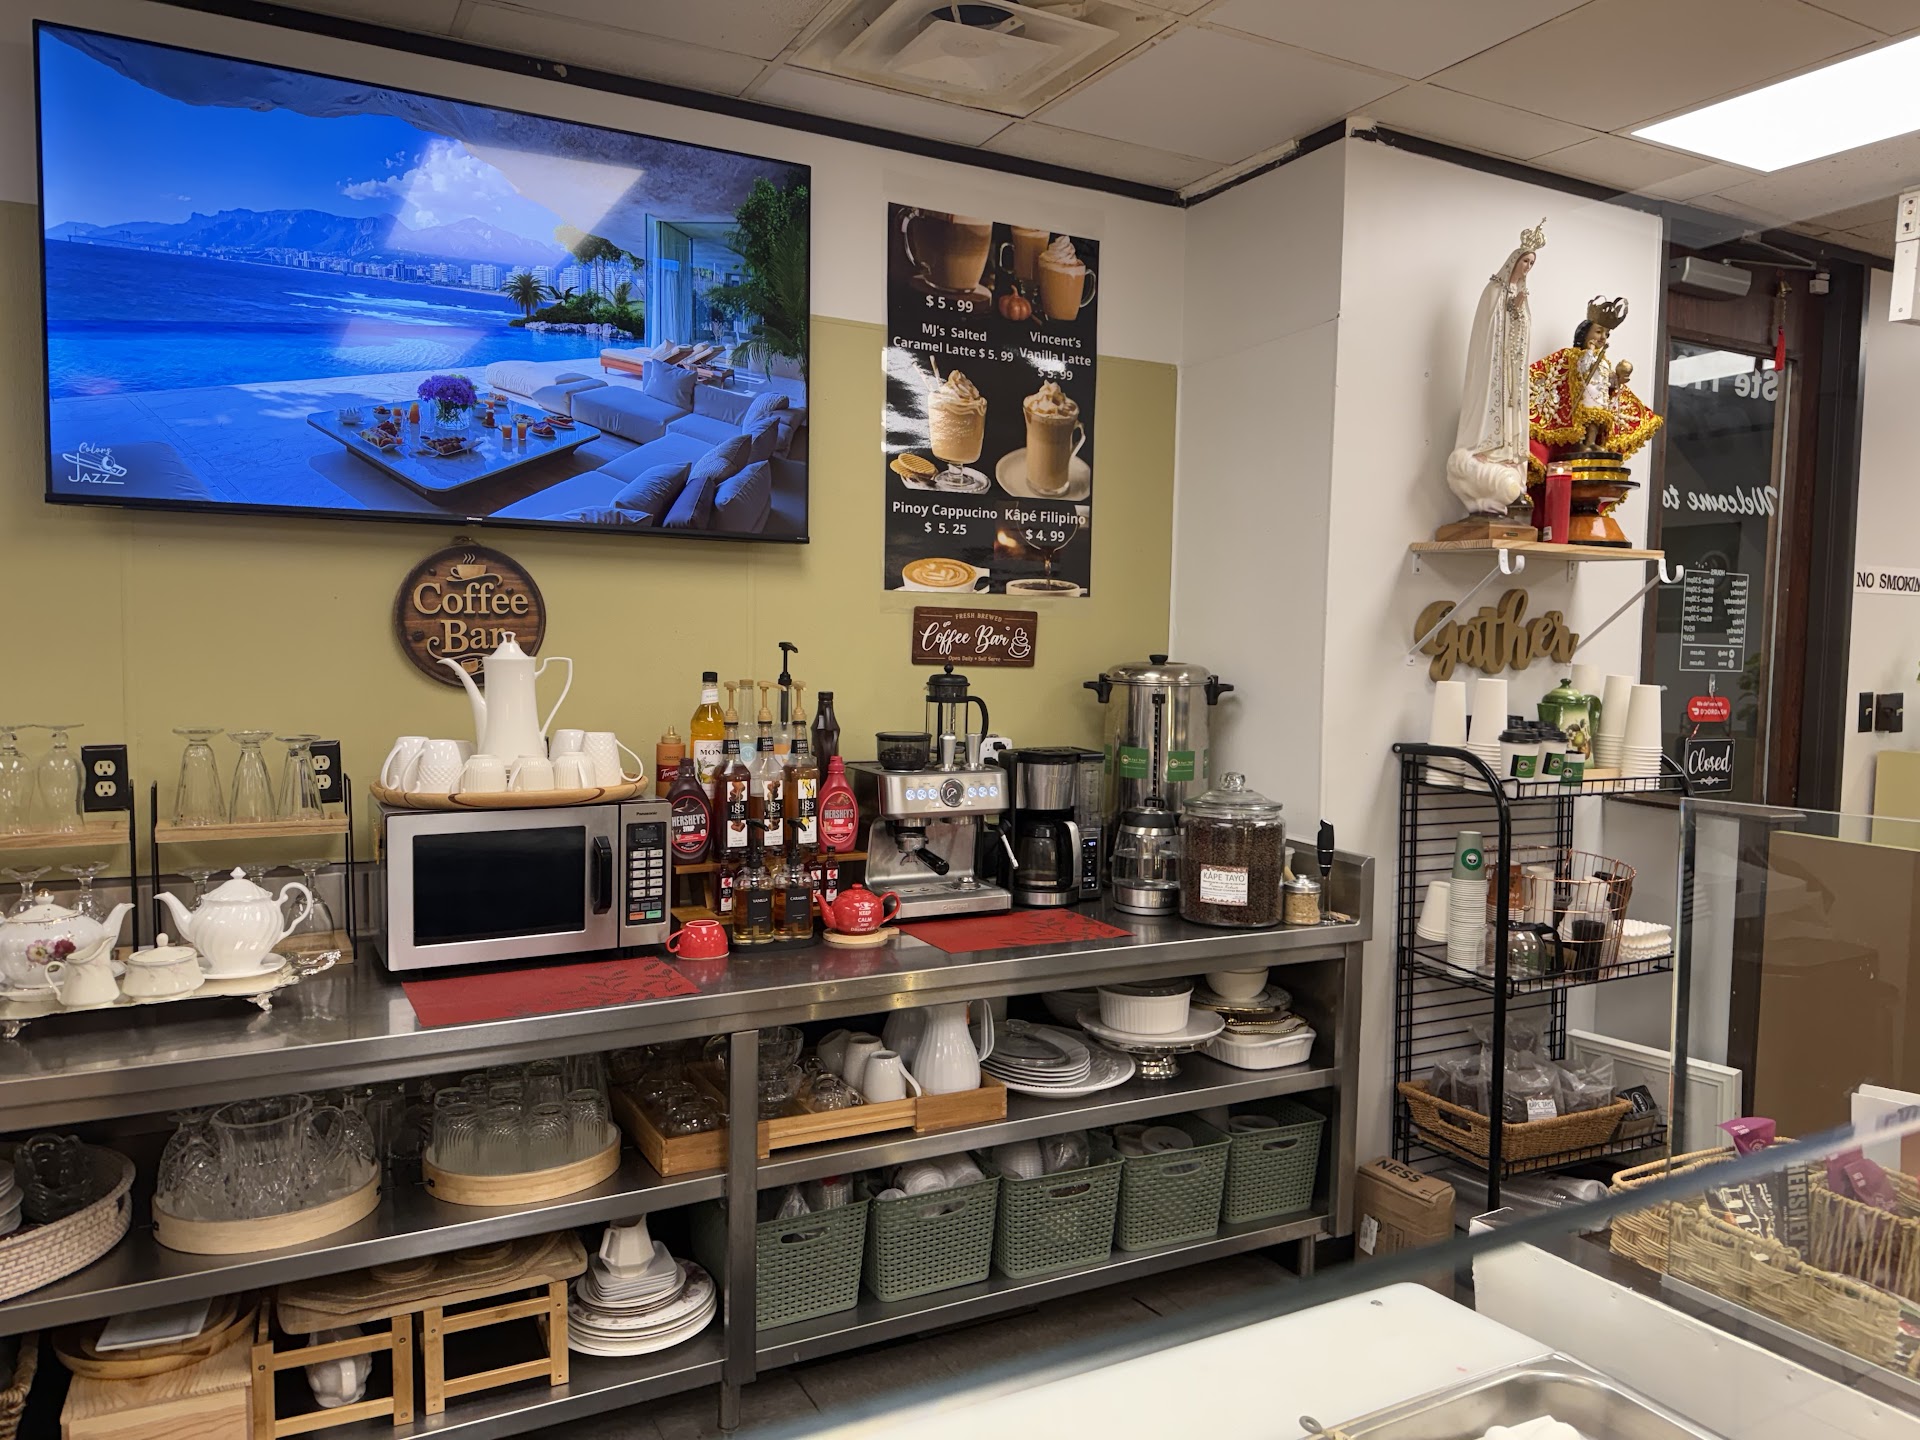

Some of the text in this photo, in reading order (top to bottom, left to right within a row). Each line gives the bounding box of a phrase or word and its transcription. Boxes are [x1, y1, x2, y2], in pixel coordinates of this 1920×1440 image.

[922, 323, 986, 342] MJ's Salted
[1030, 331, 1081, 348] Vincent's
[893, 336, 942, 353] Caramel
[946, 344, 976, 357] Latte
[1020, 348, 1091, 366] Vanilla Latte
[79, 442, 112, 454] Colors
[893, 502, 997, 519] Pinoy Cappucino
[1005, 509, 1086, 525] Kâpé Filipino
[1856, 572, 1874, 588] NO
[413, 582, 528, 614] Coffee
[977, 613, 1002, 622] BREWED
[440, 620, 507, 652] Bar
[920, 622, 1009, 654] Coffee Bar
[1689, 745, 1731, 774] Closed
[672, 814, 705, 827] HERSHEY'S
[824, 809, 854, 818] HERSHEY'S
[1225, 874, 1244, 882] TAYO
[1376, 1159, 1424, 1183] NESS
